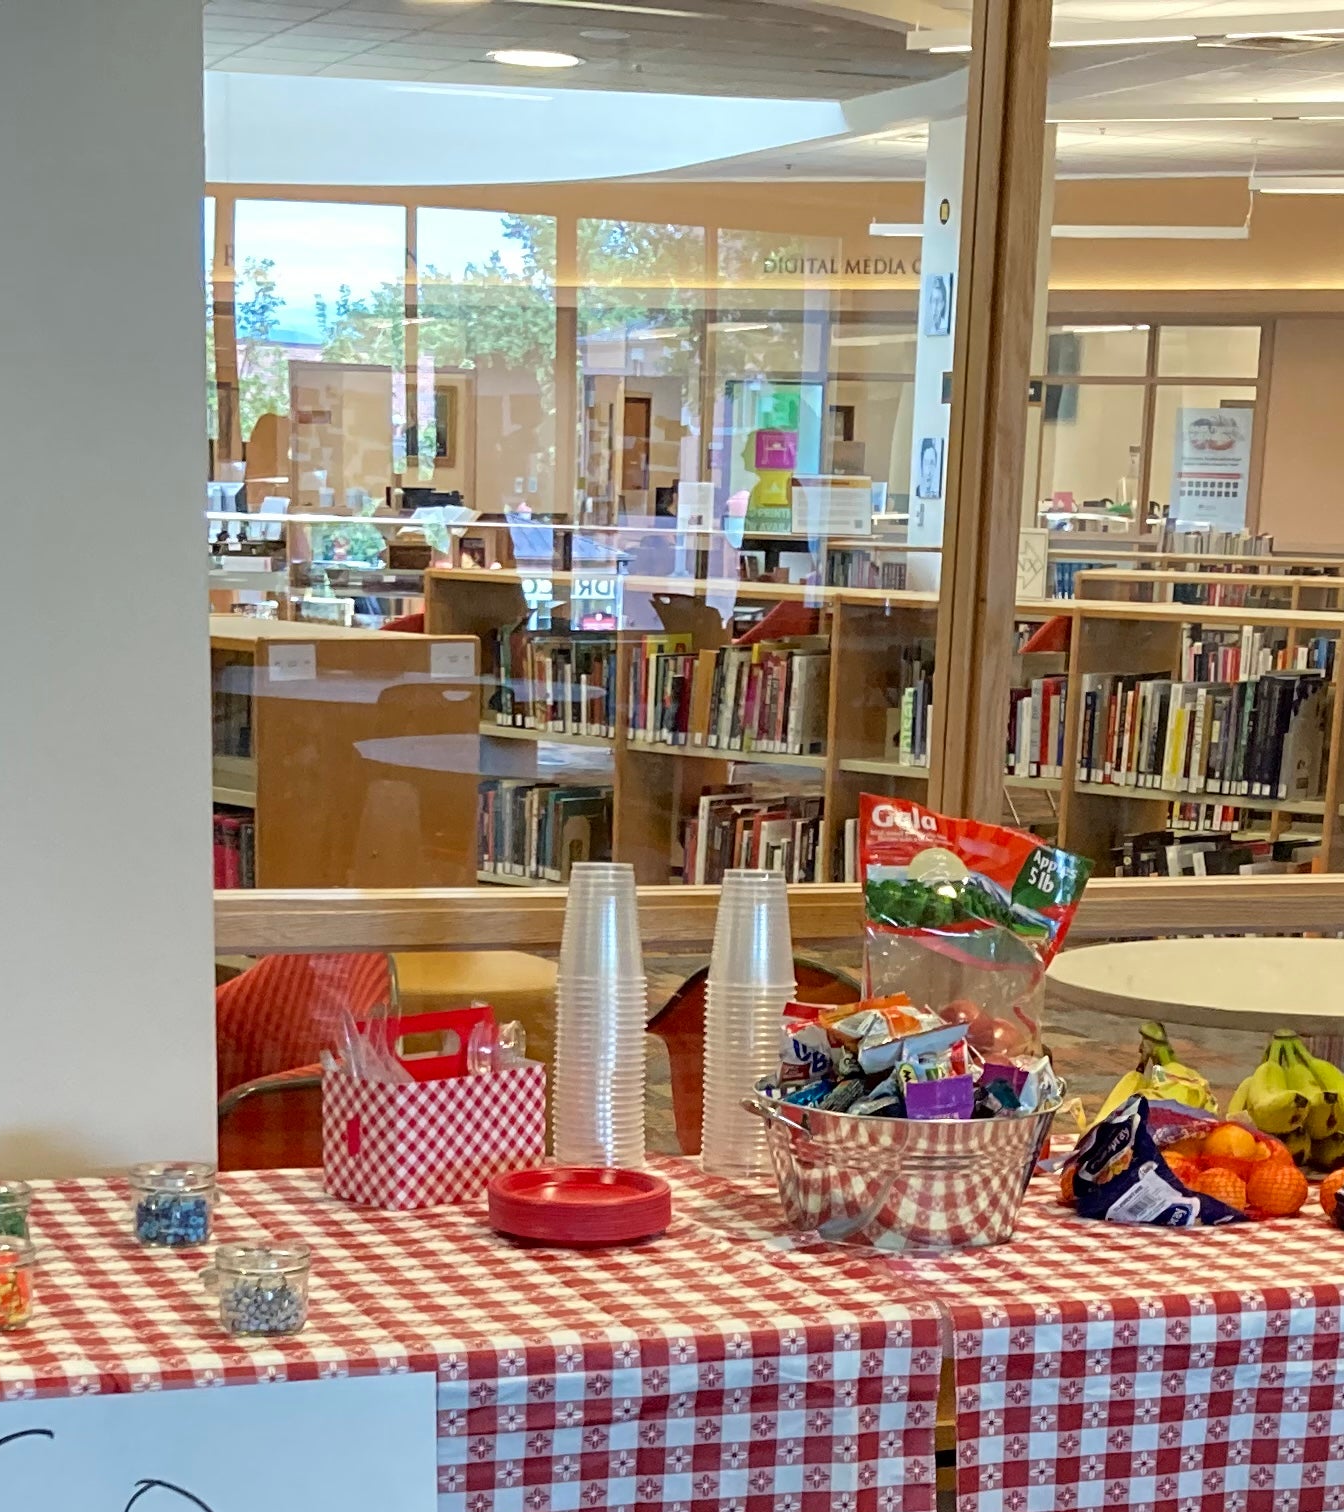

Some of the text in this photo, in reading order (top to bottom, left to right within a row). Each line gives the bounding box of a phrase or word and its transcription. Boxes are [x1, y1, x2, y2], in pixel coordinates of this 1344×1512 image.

[763, 256, 838, 275] DIGITAL
[844, 257, 906, 276] MEDIA
[871, 804, 938, 833] Gala
